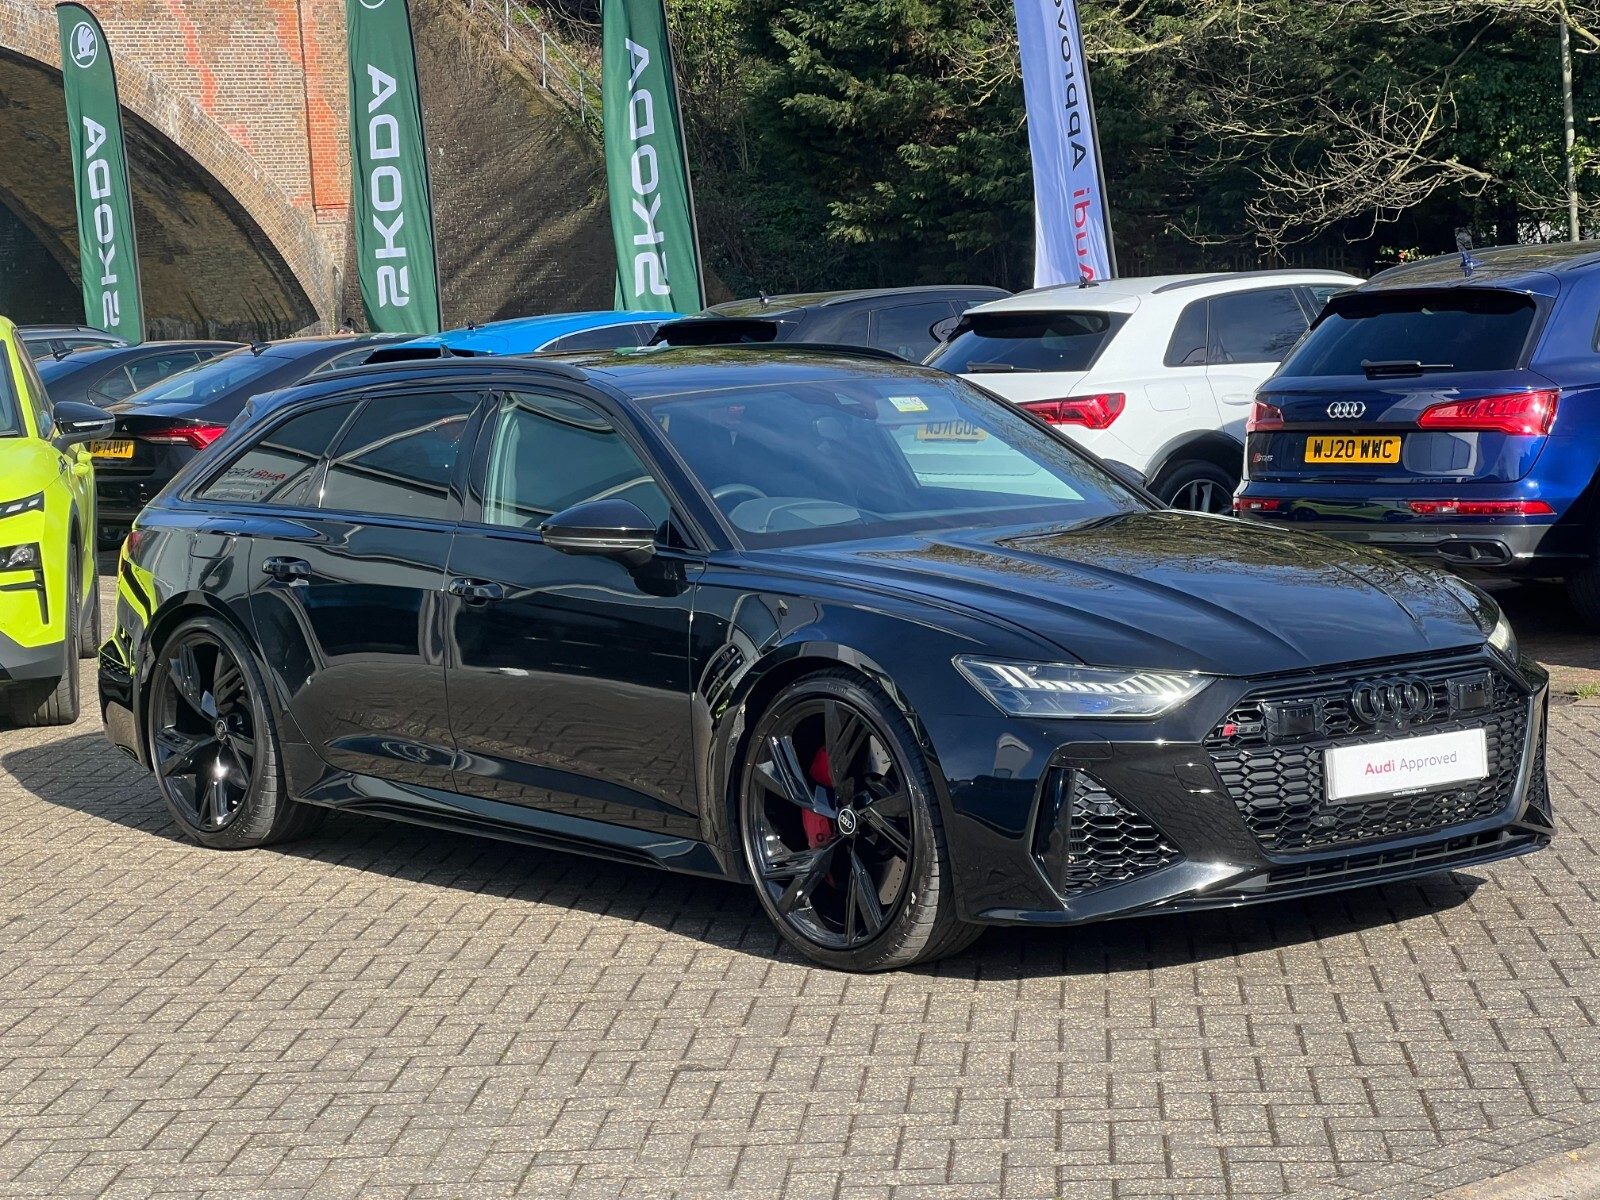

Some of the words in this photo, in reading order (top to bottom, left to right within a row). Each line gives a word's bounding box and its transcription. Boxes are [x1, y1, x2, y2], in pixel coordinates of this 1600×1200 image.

[1313, 439, 1356, 459] WJ20
[1360, 439, 1394, 459] WWC
[1364, 759, 1395, 776] Audi
[1399, 750, 1457, 772] Approved
